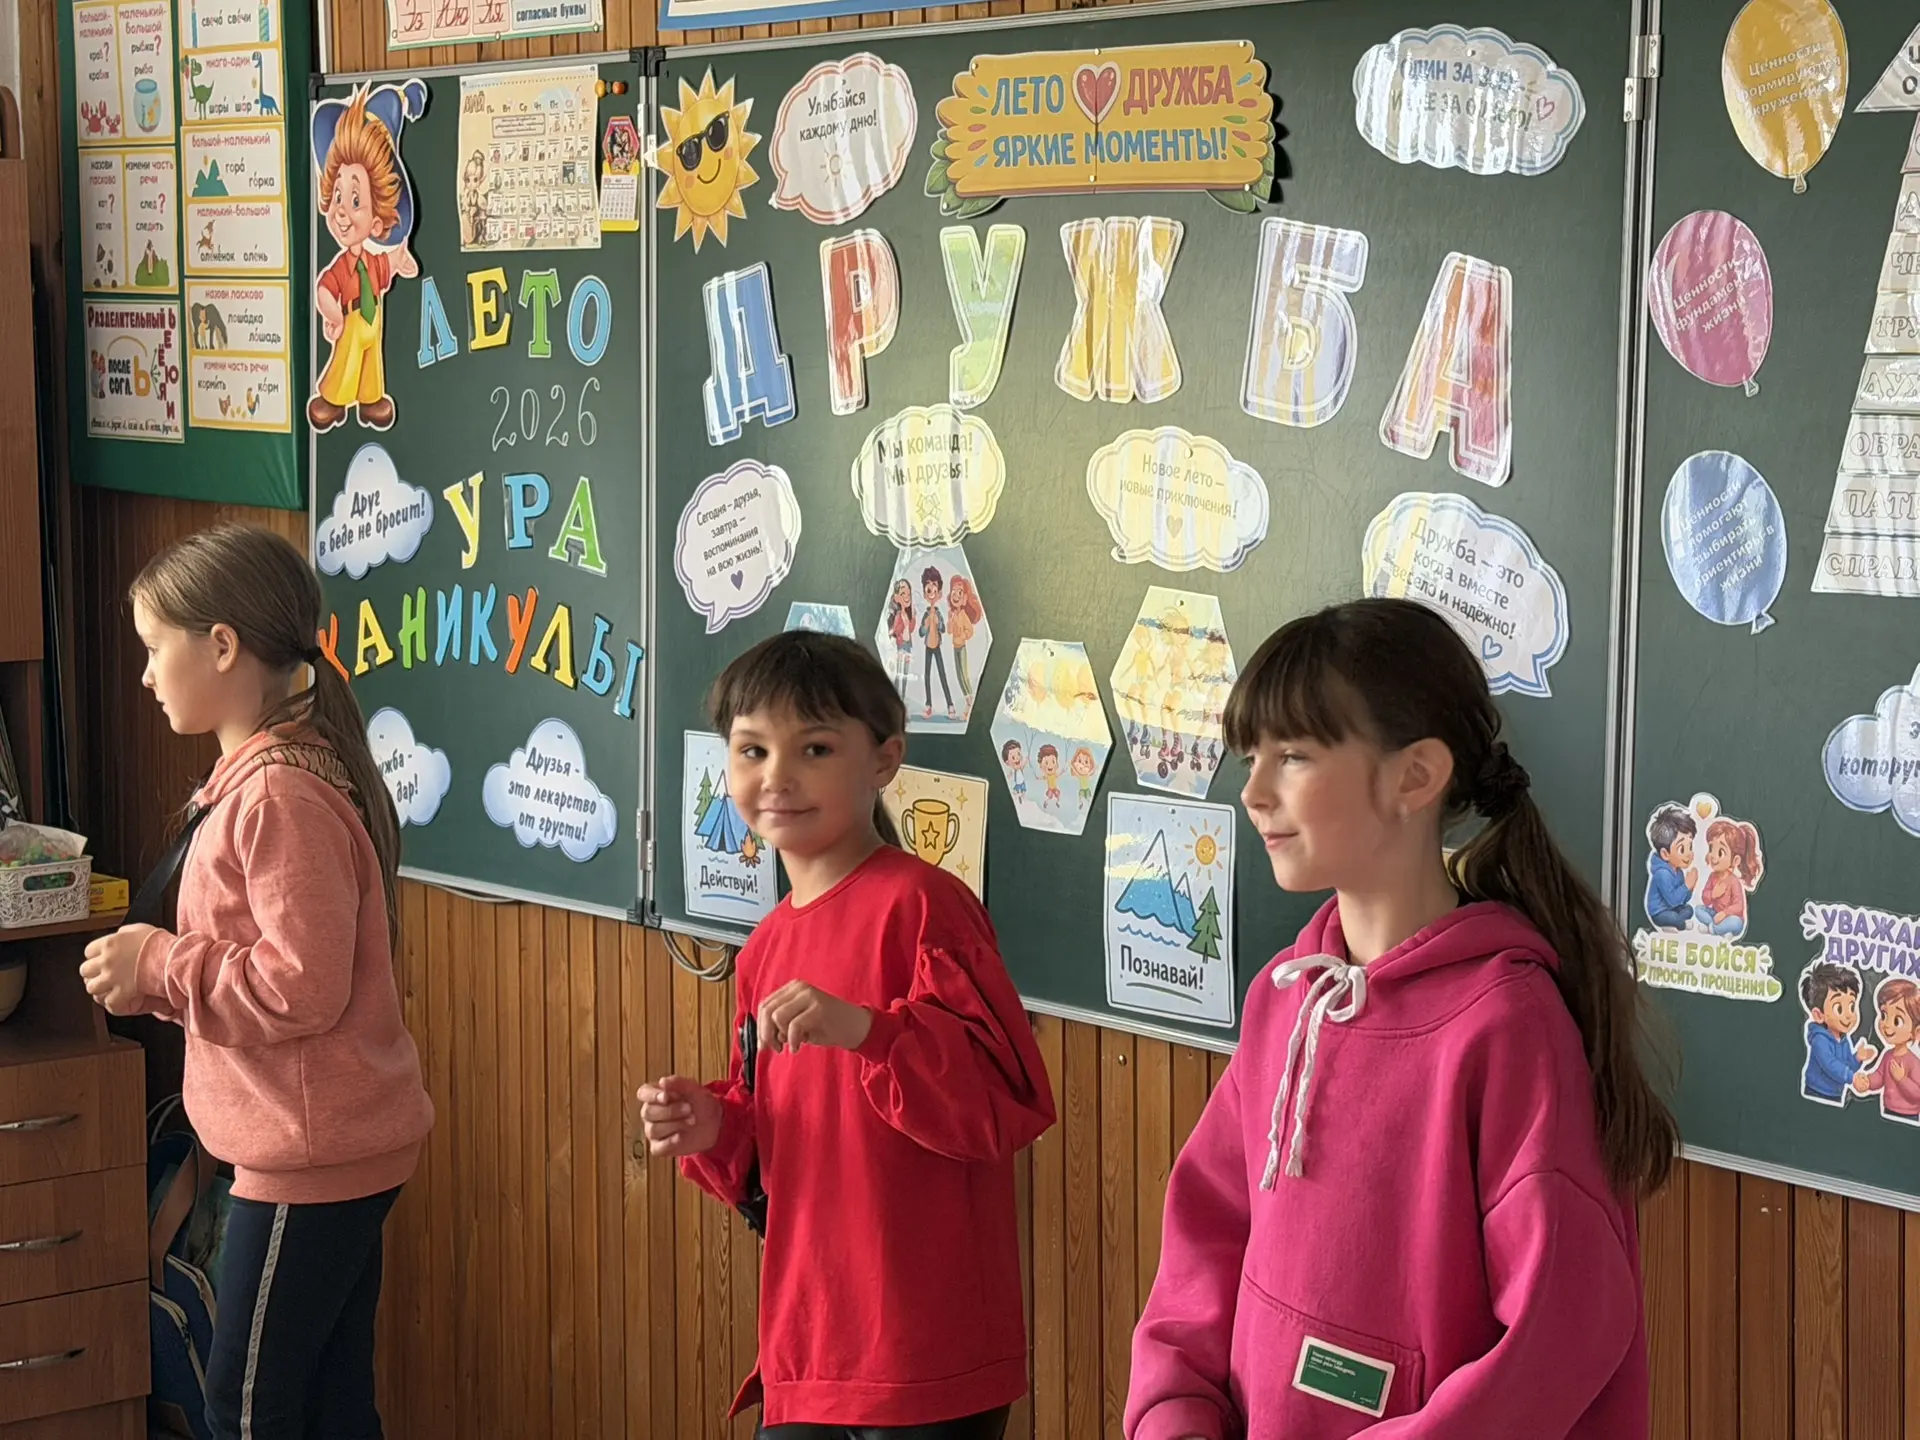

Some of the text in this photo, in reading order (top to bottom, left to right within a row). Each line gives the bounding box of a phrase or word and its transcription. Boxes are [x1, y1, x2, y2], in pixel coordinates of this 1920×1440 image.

[516, 3, 587, 23] согласные буквы
[1452, 61, 1473, 85] ЗА
[1749, 42, 1822, 77] Ценности
[807, 89, 866, 117] Улыбайся
[991, 64, 1234, 117] ЛЕТО ДРУЖБА
[799, 109, 877, 142] каждому дню!
[993, 127, 1228, 168] ЯРКИЕ МОМЕНТЫ!
[1673, 259, 1741, 311] Ценности
[416, 267, 613, 369] ЛЕТО
[1675, 278, 1744, 331] фундамен
[1702, 297, 1746, 334] жизни
[108, 358, 131, 375] ПОСЛЕ
[703, 215, 1513, 488] ДРУЖБА
[490, 377, 601, 452] 2026
[877, 431, 974, 464] Мы команда!
[916, 458, 969, 485] друзья!
[1142, 453, 1181, 479] Новое
[1184, 465, 1213, 488] лето
[350, 489, 381, 519] Друг
[696, 502, 727, 527] Сегодня
[733, 487, 762, 511] друзья,
[1119, 479, 1238, 519] новые приключения!
[319, 492, 425, 557] в беде не бросит!
[443, 470, 607, 577] УРА
[710, 517, 738, 539] завтра
[703, 526, 759, 561] воспоминания
[706, 540, 764, 578] на всю жизнь!
[1411, 517, 1476, 567] Дружба
[1497, 563, 1525, 589] это
[1413, 550, 1510, 610] когда вместе
[1720, 555, 1764, 593] жизни
[1824, 552, 1920, 581] СПРАВ
[1392, 565, 1517, 640] весело и надёжно!
[525, 746, 571, 777] Друзья
[396, 772, 419, 805] дар!
[508, 779, 598, 815] это лекарство
[518, 811, 588, 843] от грусти!
[700, 865, 758, 896] Действуй!
[1120, 944, 1204, 990] Познавай!
[1650, 938, 1757, 974] НЕ БОЙСЯ
[1650, 965, 1765, 997] ПРОСИТЬ ПРОЩЕНИЯ
